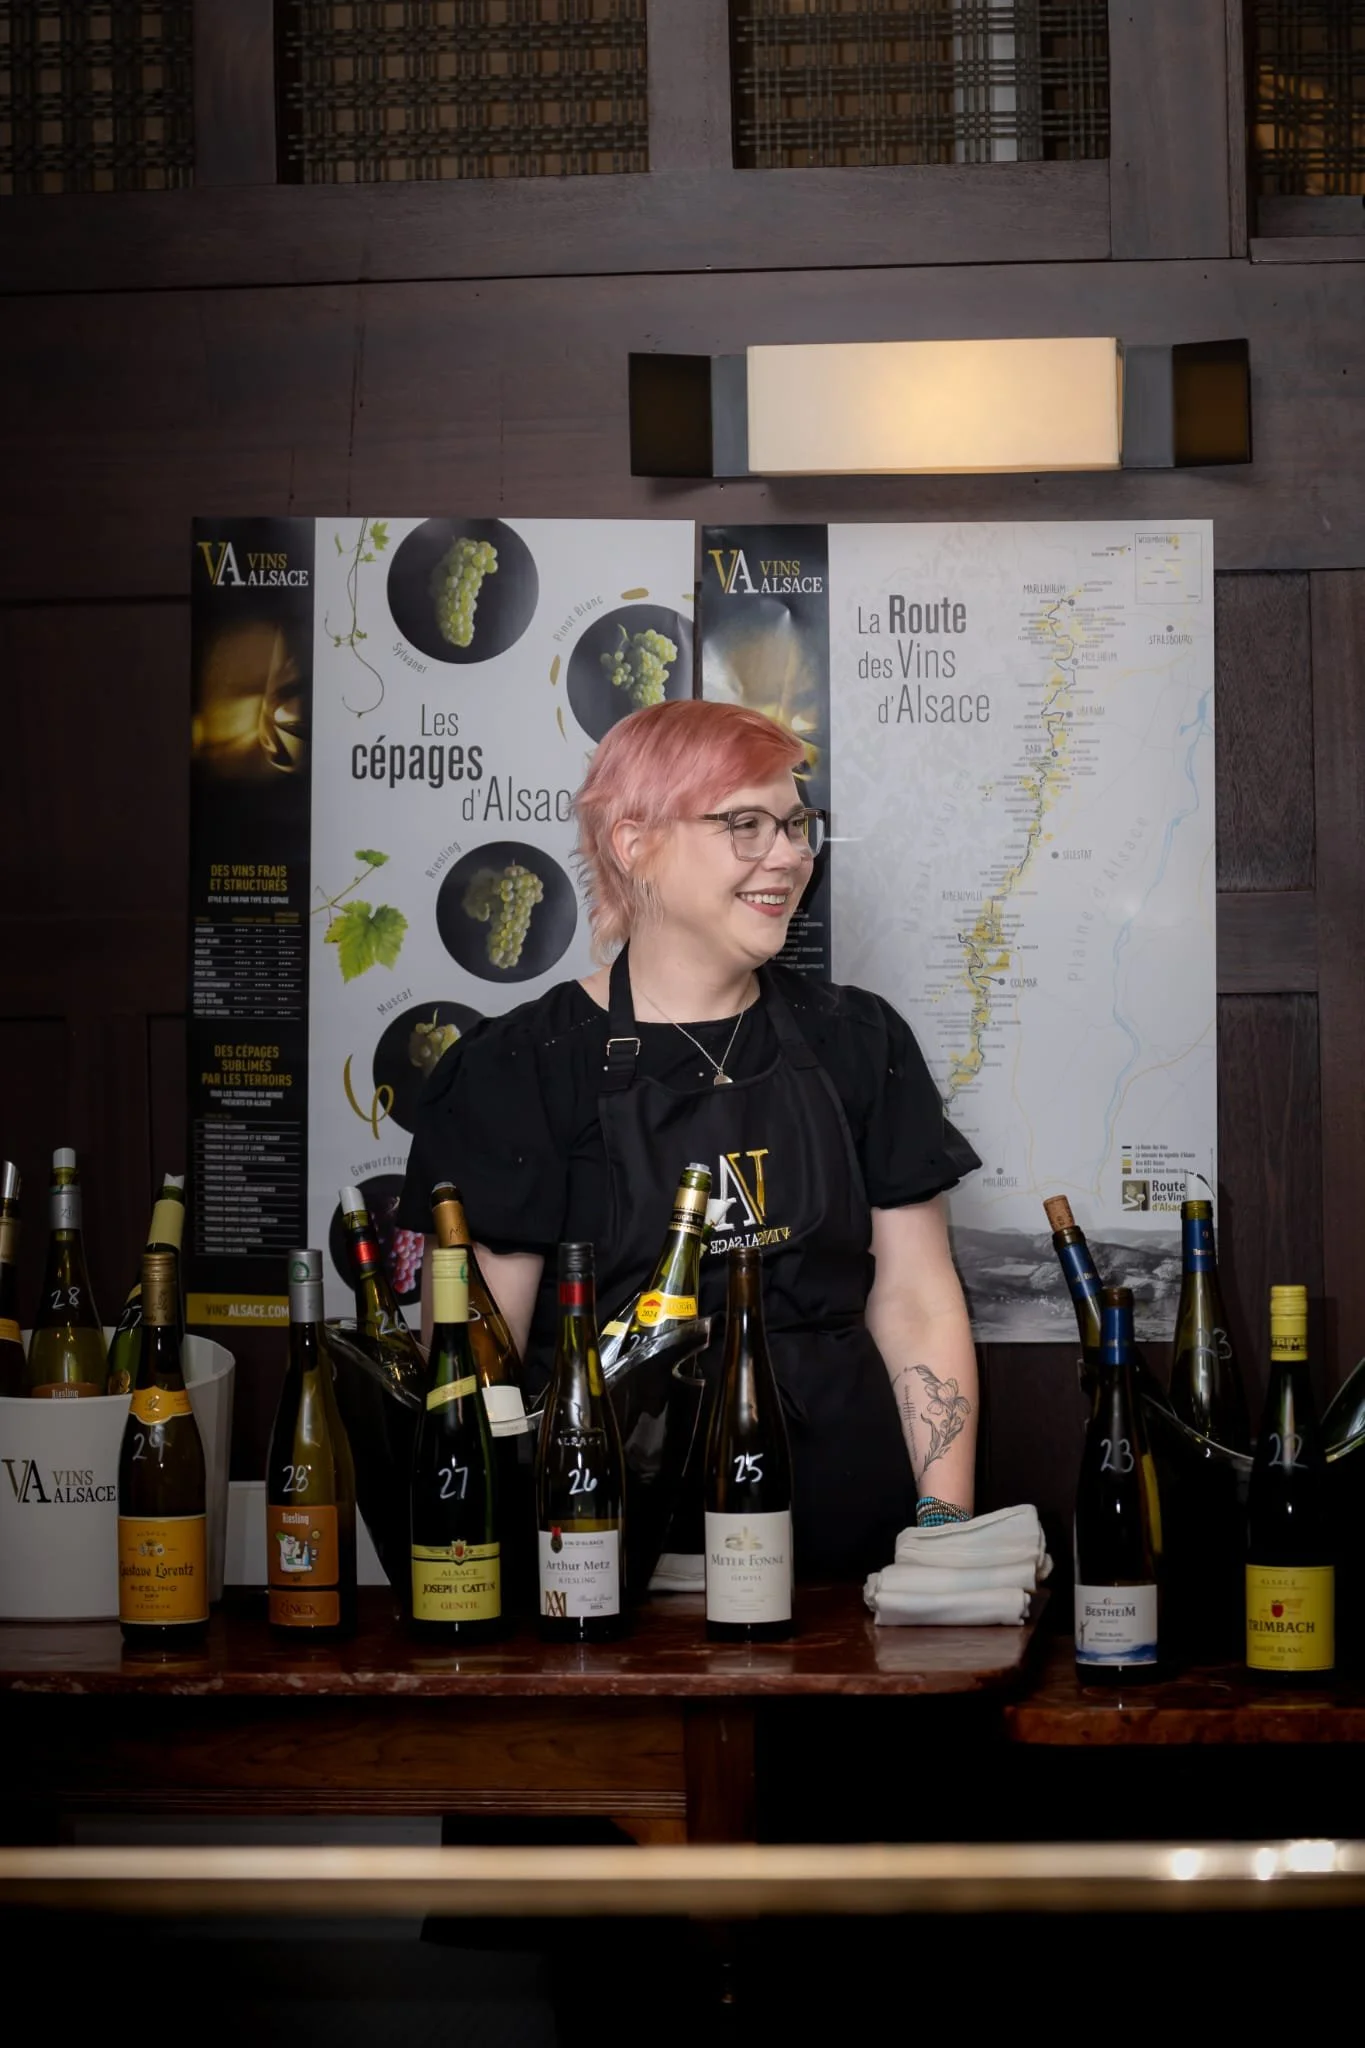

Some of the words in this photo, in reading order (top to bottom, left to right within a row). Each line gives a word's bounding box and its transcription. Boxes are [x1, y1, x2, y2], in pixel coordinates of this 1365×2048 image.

[247, 553, 287, 570] VINS
[760, 560, 800, 577] VINS
[247, 570, 309, 586] ALSACE
[760, 577, 823, 594] ALSACE
[552, 615, 576, 642] Pinot
[573, 596, 603, 617] Blanc
[858, 607, 880, 634] La
[889, 595, 966, 634] Route
[391, 642, 428, 675] Sylvaner
[858, 651, 893, 679] des
[898, 640, 956, 679] Vins
[878, 684, 990, 724] d'Alsace
[421, 703, 459, 737] Les
[352, 735, 483, 789] cépages
[462, 776, 572, 822] d'Alsac
[426, 840, 461, 879] Riesling
[210, 865, 230, 877] DES
[232, 865, 255, 877] VINS
[258, 865, 287, 878] FRAIS
[210, 879, 221, 891] ET
[223, 877, 288, 891] STRUCTURÉS
[377, 989, 413, 1015] Muscat
[214, 1045, 233, 1057] DES
[235, 1043, 279, 1058] CÉPAGES
[222, 1058, 272, 1072] SUBLIMÉS
[202, 1073, 221, 1085] PAR
[223, 1074, 241, 1086] LES
[244, 1074, 293, 1087] TERROIRS
[1152, 1180, 1186, 1192] Route
[1152, 1192, 1166, 1202] des
[1167, 1192, 1185, 1202] Vins
[1152, 1202, 1182, 1212] d'Alsac
[51, 1286, 81, 1310] 28
[1099, 1438, 1135, 1473] 23
[1268, 1432, 1309, 1469] 22
[734, 1453, 764, 1483] 25
[52, 1471, 94, 1486] VINS
[282, 1465, 310, 1492] 28
[438, 1466, 468, 1500] 27
[568, 1468, 598, 1495] 26
[54, 1486, 117, 1503] ALSACE
[282, 1512, 310, 1525] Riesling
[440, 1569, 479, 1577] ALSACE
[546, 1560, 580, 1571] Arthur
[584, 1560, 610, 1570] Metz
[422, 1584, 458, 1594] JOSEPH
[440, 1600, 480, 1610] GENTIL
[1085, 1606, 1136, 1617] BESTHEIM
[1248, 1618, 1315, 1633] TRIMBACH
[1277, 1646, 1305, 1654] BLANC
